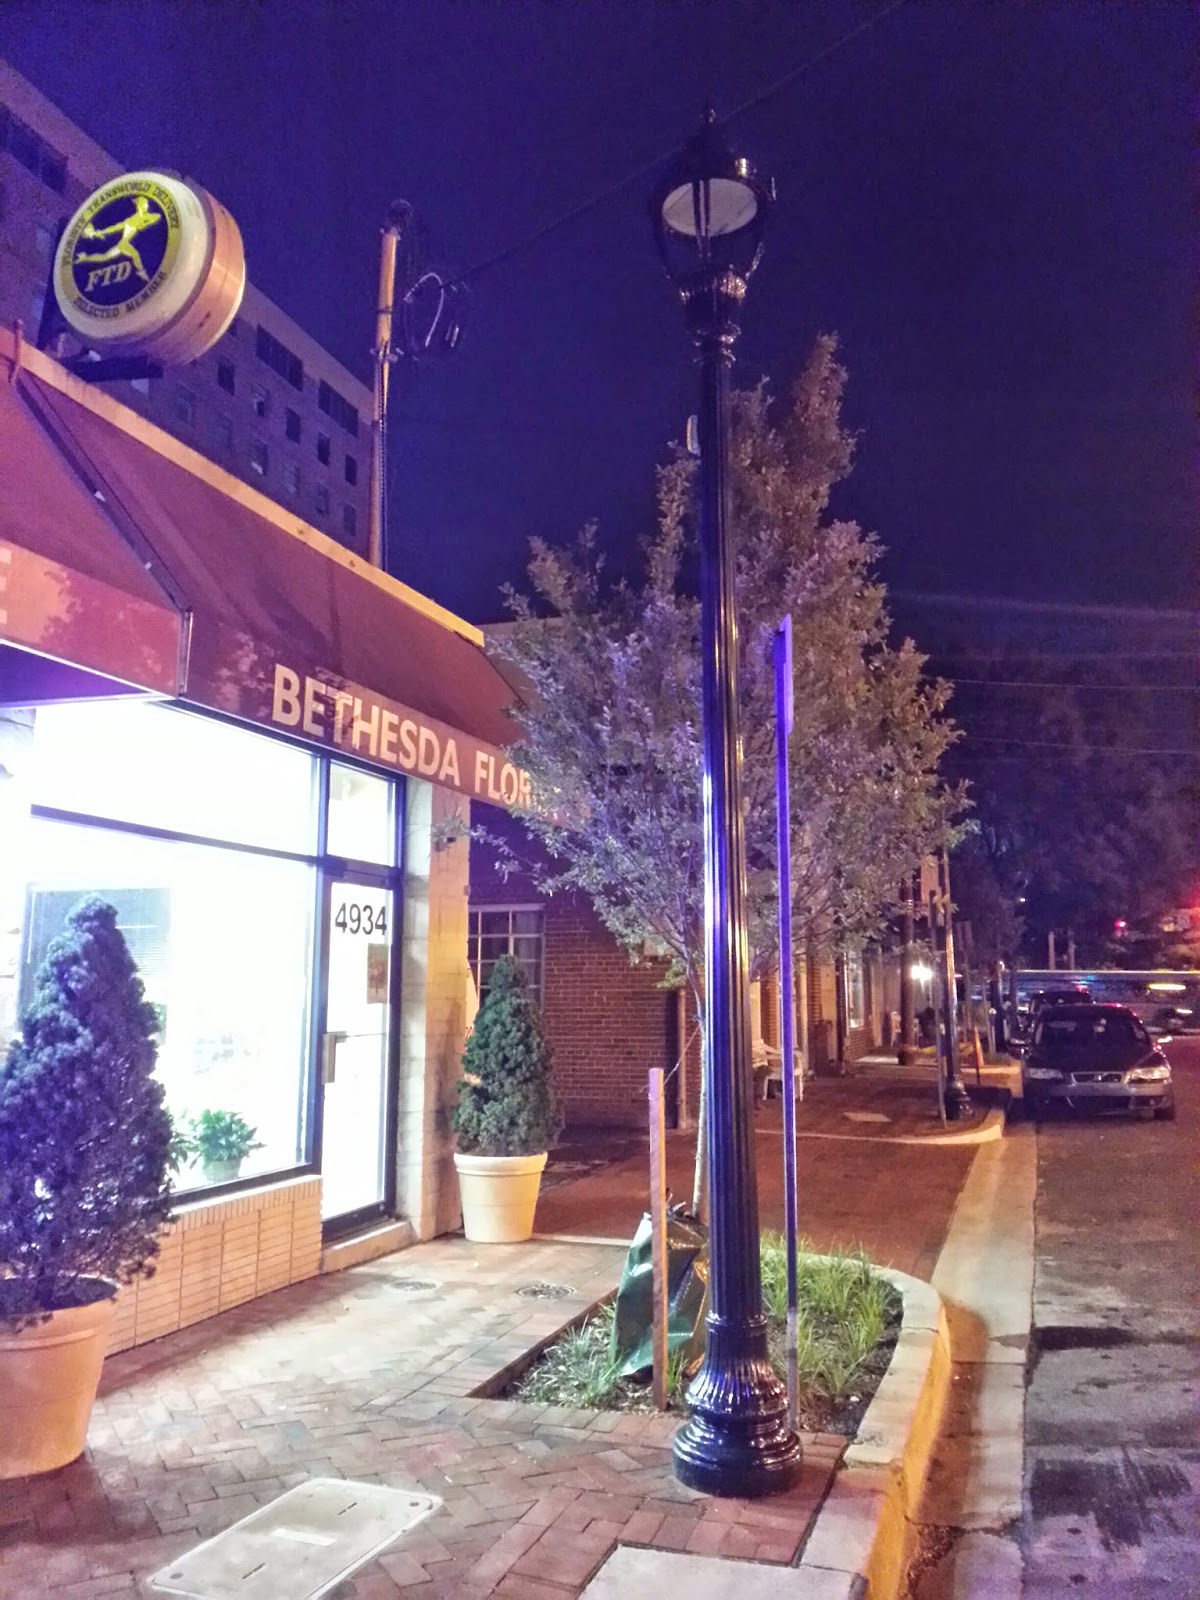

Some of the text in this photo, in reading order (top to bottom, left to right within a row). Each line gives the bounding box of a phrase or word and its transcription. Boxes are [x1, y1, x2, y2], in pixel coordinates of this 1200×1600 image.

[84, 260, 132, 292] FTD
[271, 663, 558, 820] BETHESDA FLOR
[335, 902, 387, 936] 4934
